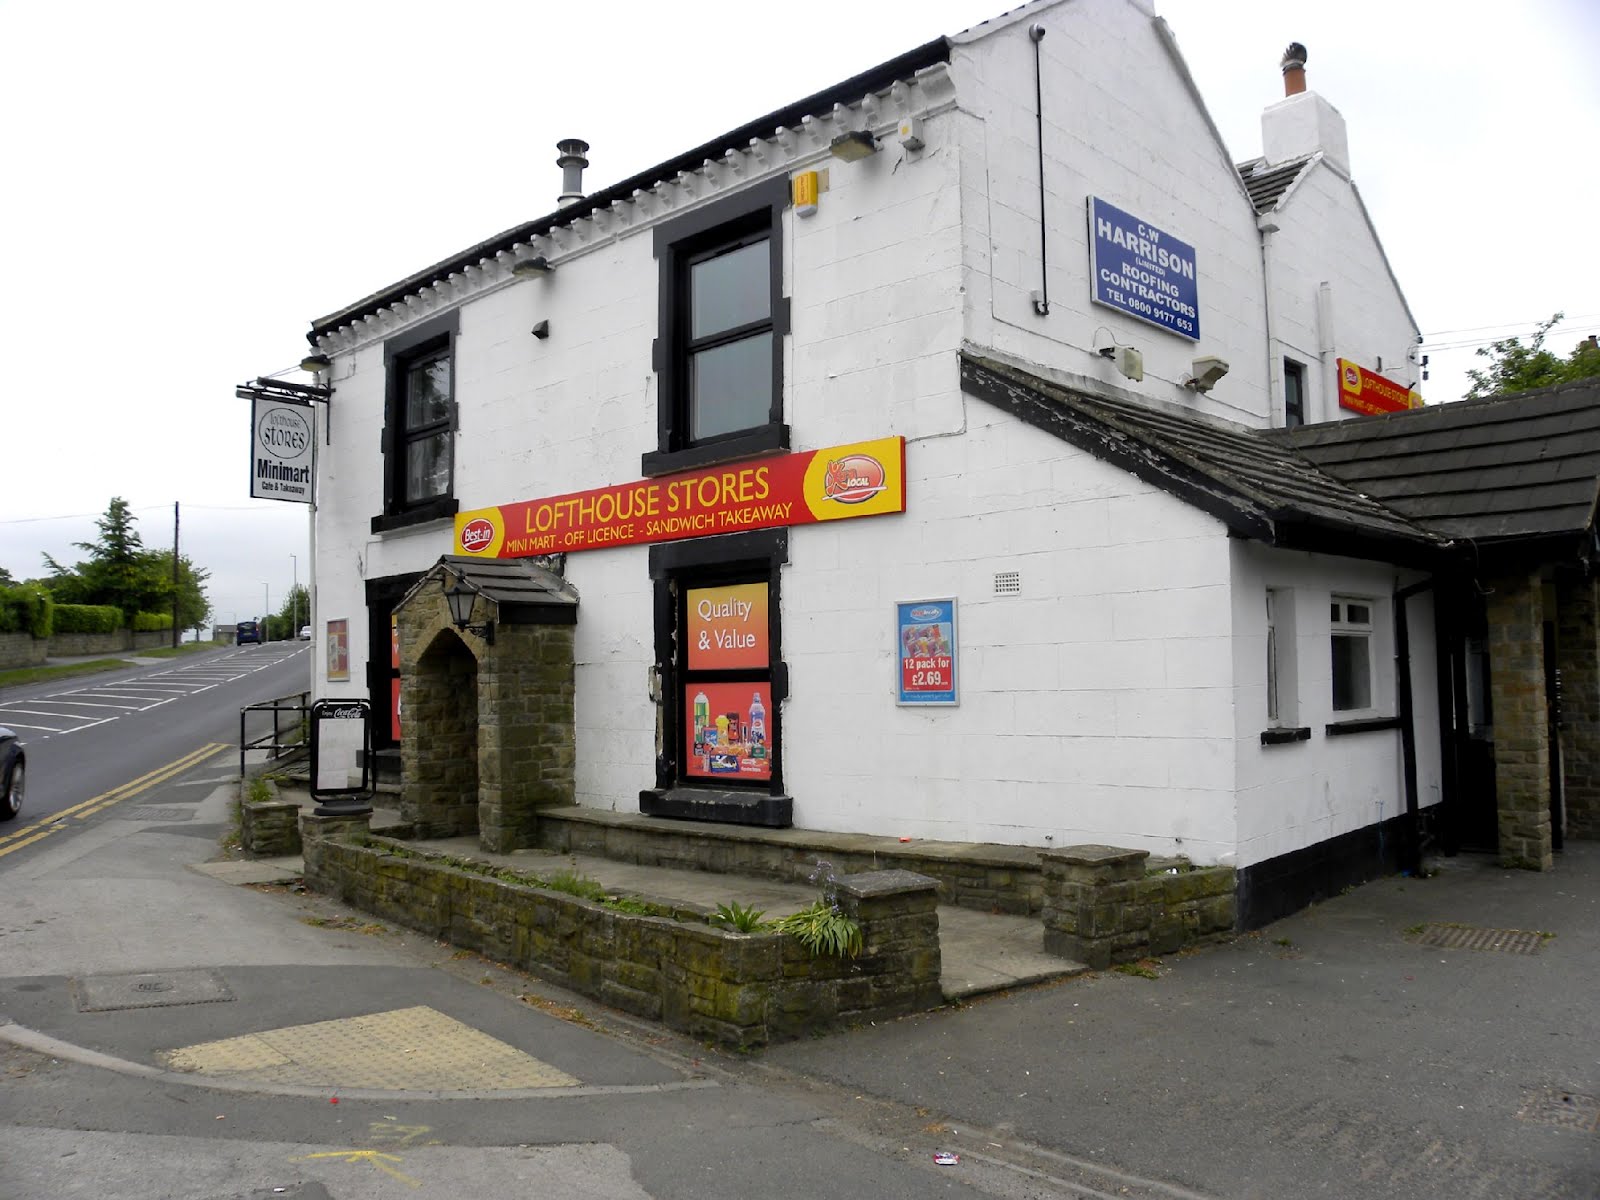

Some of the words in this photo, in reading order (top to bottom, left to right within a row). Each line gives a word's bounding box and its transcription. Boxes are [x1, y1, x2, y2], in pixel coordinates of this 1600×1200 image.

[1138, 224, 1159, 243] C.W
[1097, 217, 1194, 280] HARRISON
[1122, 262, 1180, 297] ROOFING
[1101, 268, 1196, 319] CONTRACTORS
[1106, 288, 1126, 305] TEL
[1128, 297, 1151, 315] 0800
[1153, 308, 1175, 324] 9177
[1177, 317, 1193, 332] 653
[257, 459, 310, 484] Minimart
[847, 476, 869, 488] LOCAL
[526, 485, 660, 534] LOFTHOUSE
[667, 466, 770, 512] STORES
[506, 536, 526, 553] MINI
[529, 534, 557, 551] MART
[564, 530, 585, 545] OFF
[587, 523, 634, 544] LICENCE
[646, 513, 715, 536] SANDWICH
[718, 502, 793, 527] TAKEAWAY
[697, 598, 752, 622] Quality
[698, 630, 711, 650] &
[714, 629, 756, 649] Value
[904, 658, 915, 669] 12
[916, 658, 936, 671] pack
[938, 657, 950, 668] for
[912, 671, 941, 686] £2.69
